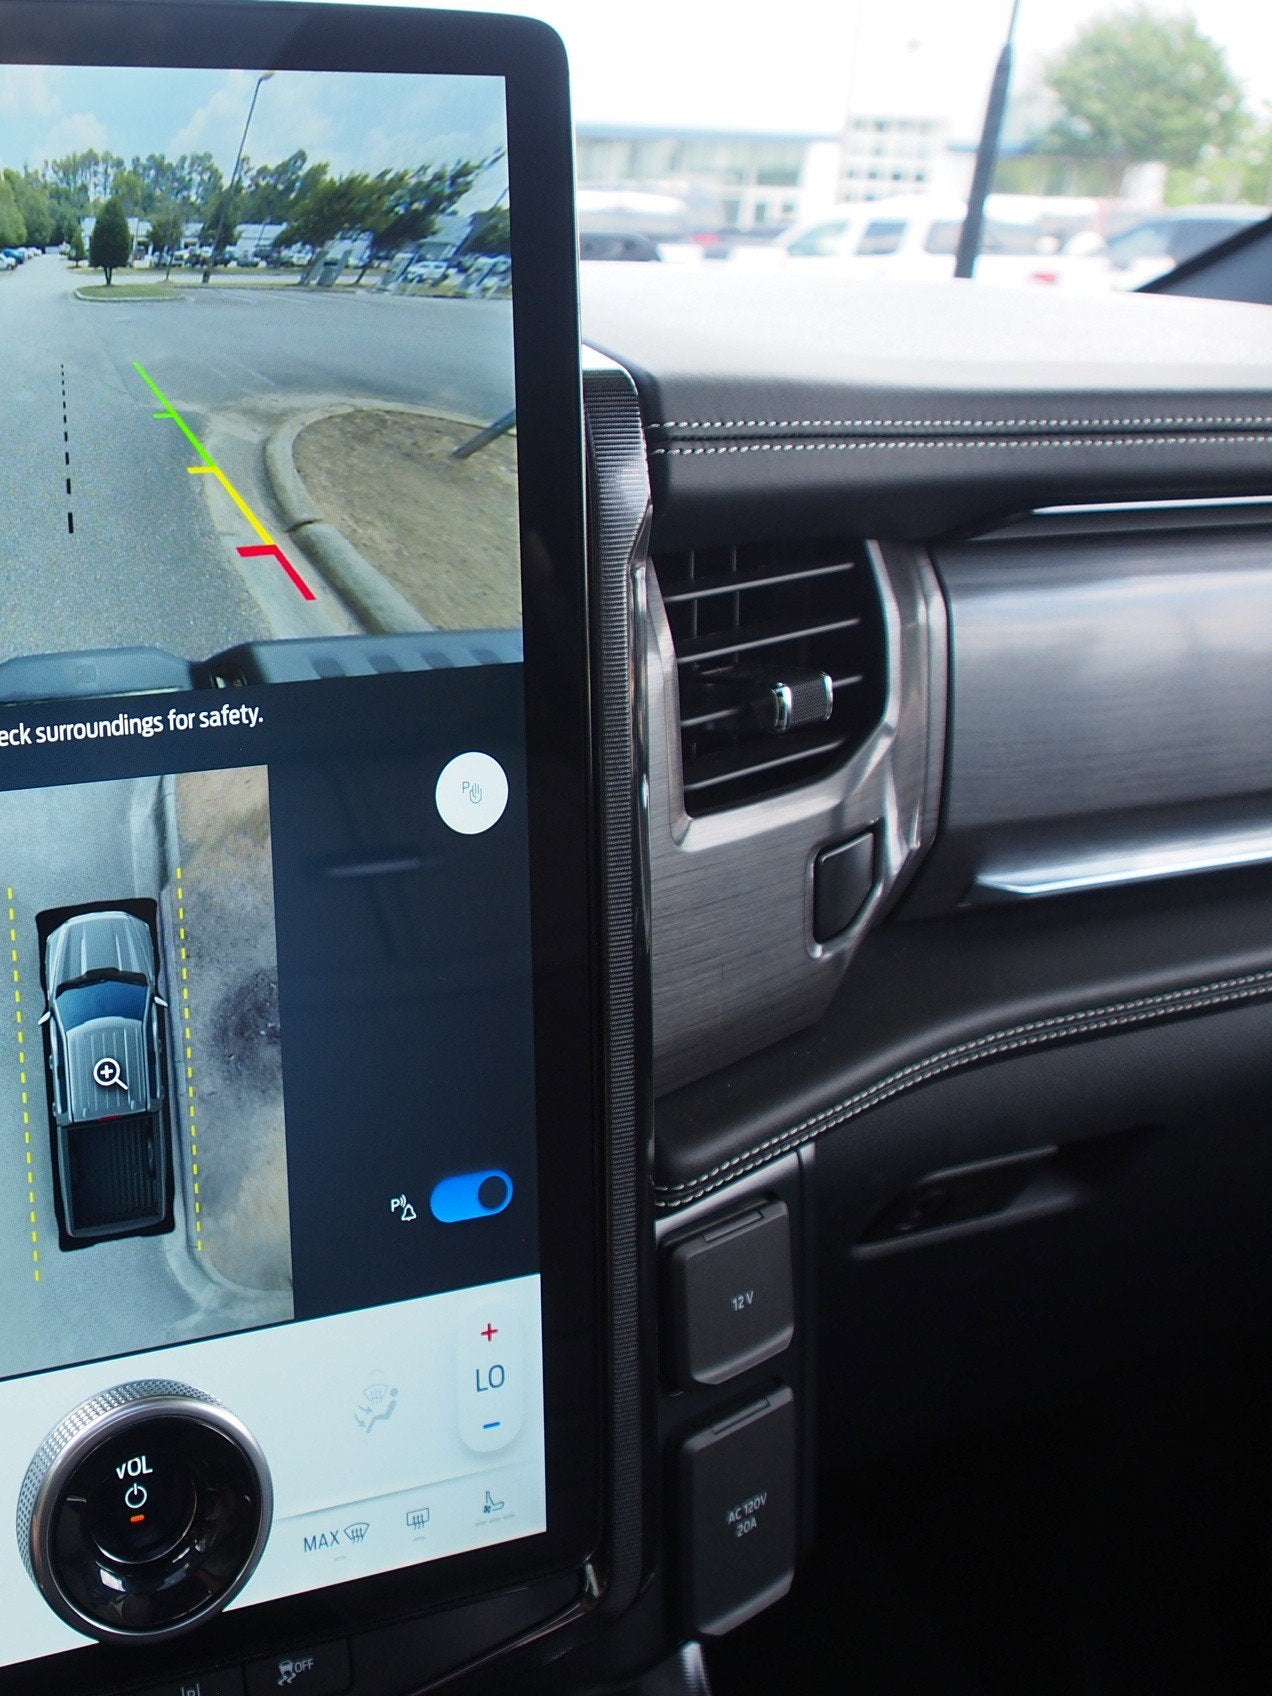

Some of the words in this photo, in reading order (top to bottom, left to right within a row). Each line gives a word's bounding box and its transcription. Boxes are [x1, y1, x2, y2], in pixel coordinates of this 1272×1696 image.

[35, 713, 164, 744] surroundings
[167, 708, 195, 731] for
[198, 704, 264, 729] safety.
[476, 1364, 505, 1392] LO
[728, 1507, 742, 1525] AC
[744, 1492, 767, 1515] 120V
[303, 1529, 341, 1553] MAX
[294, 1658, 314, 1674] OFF
